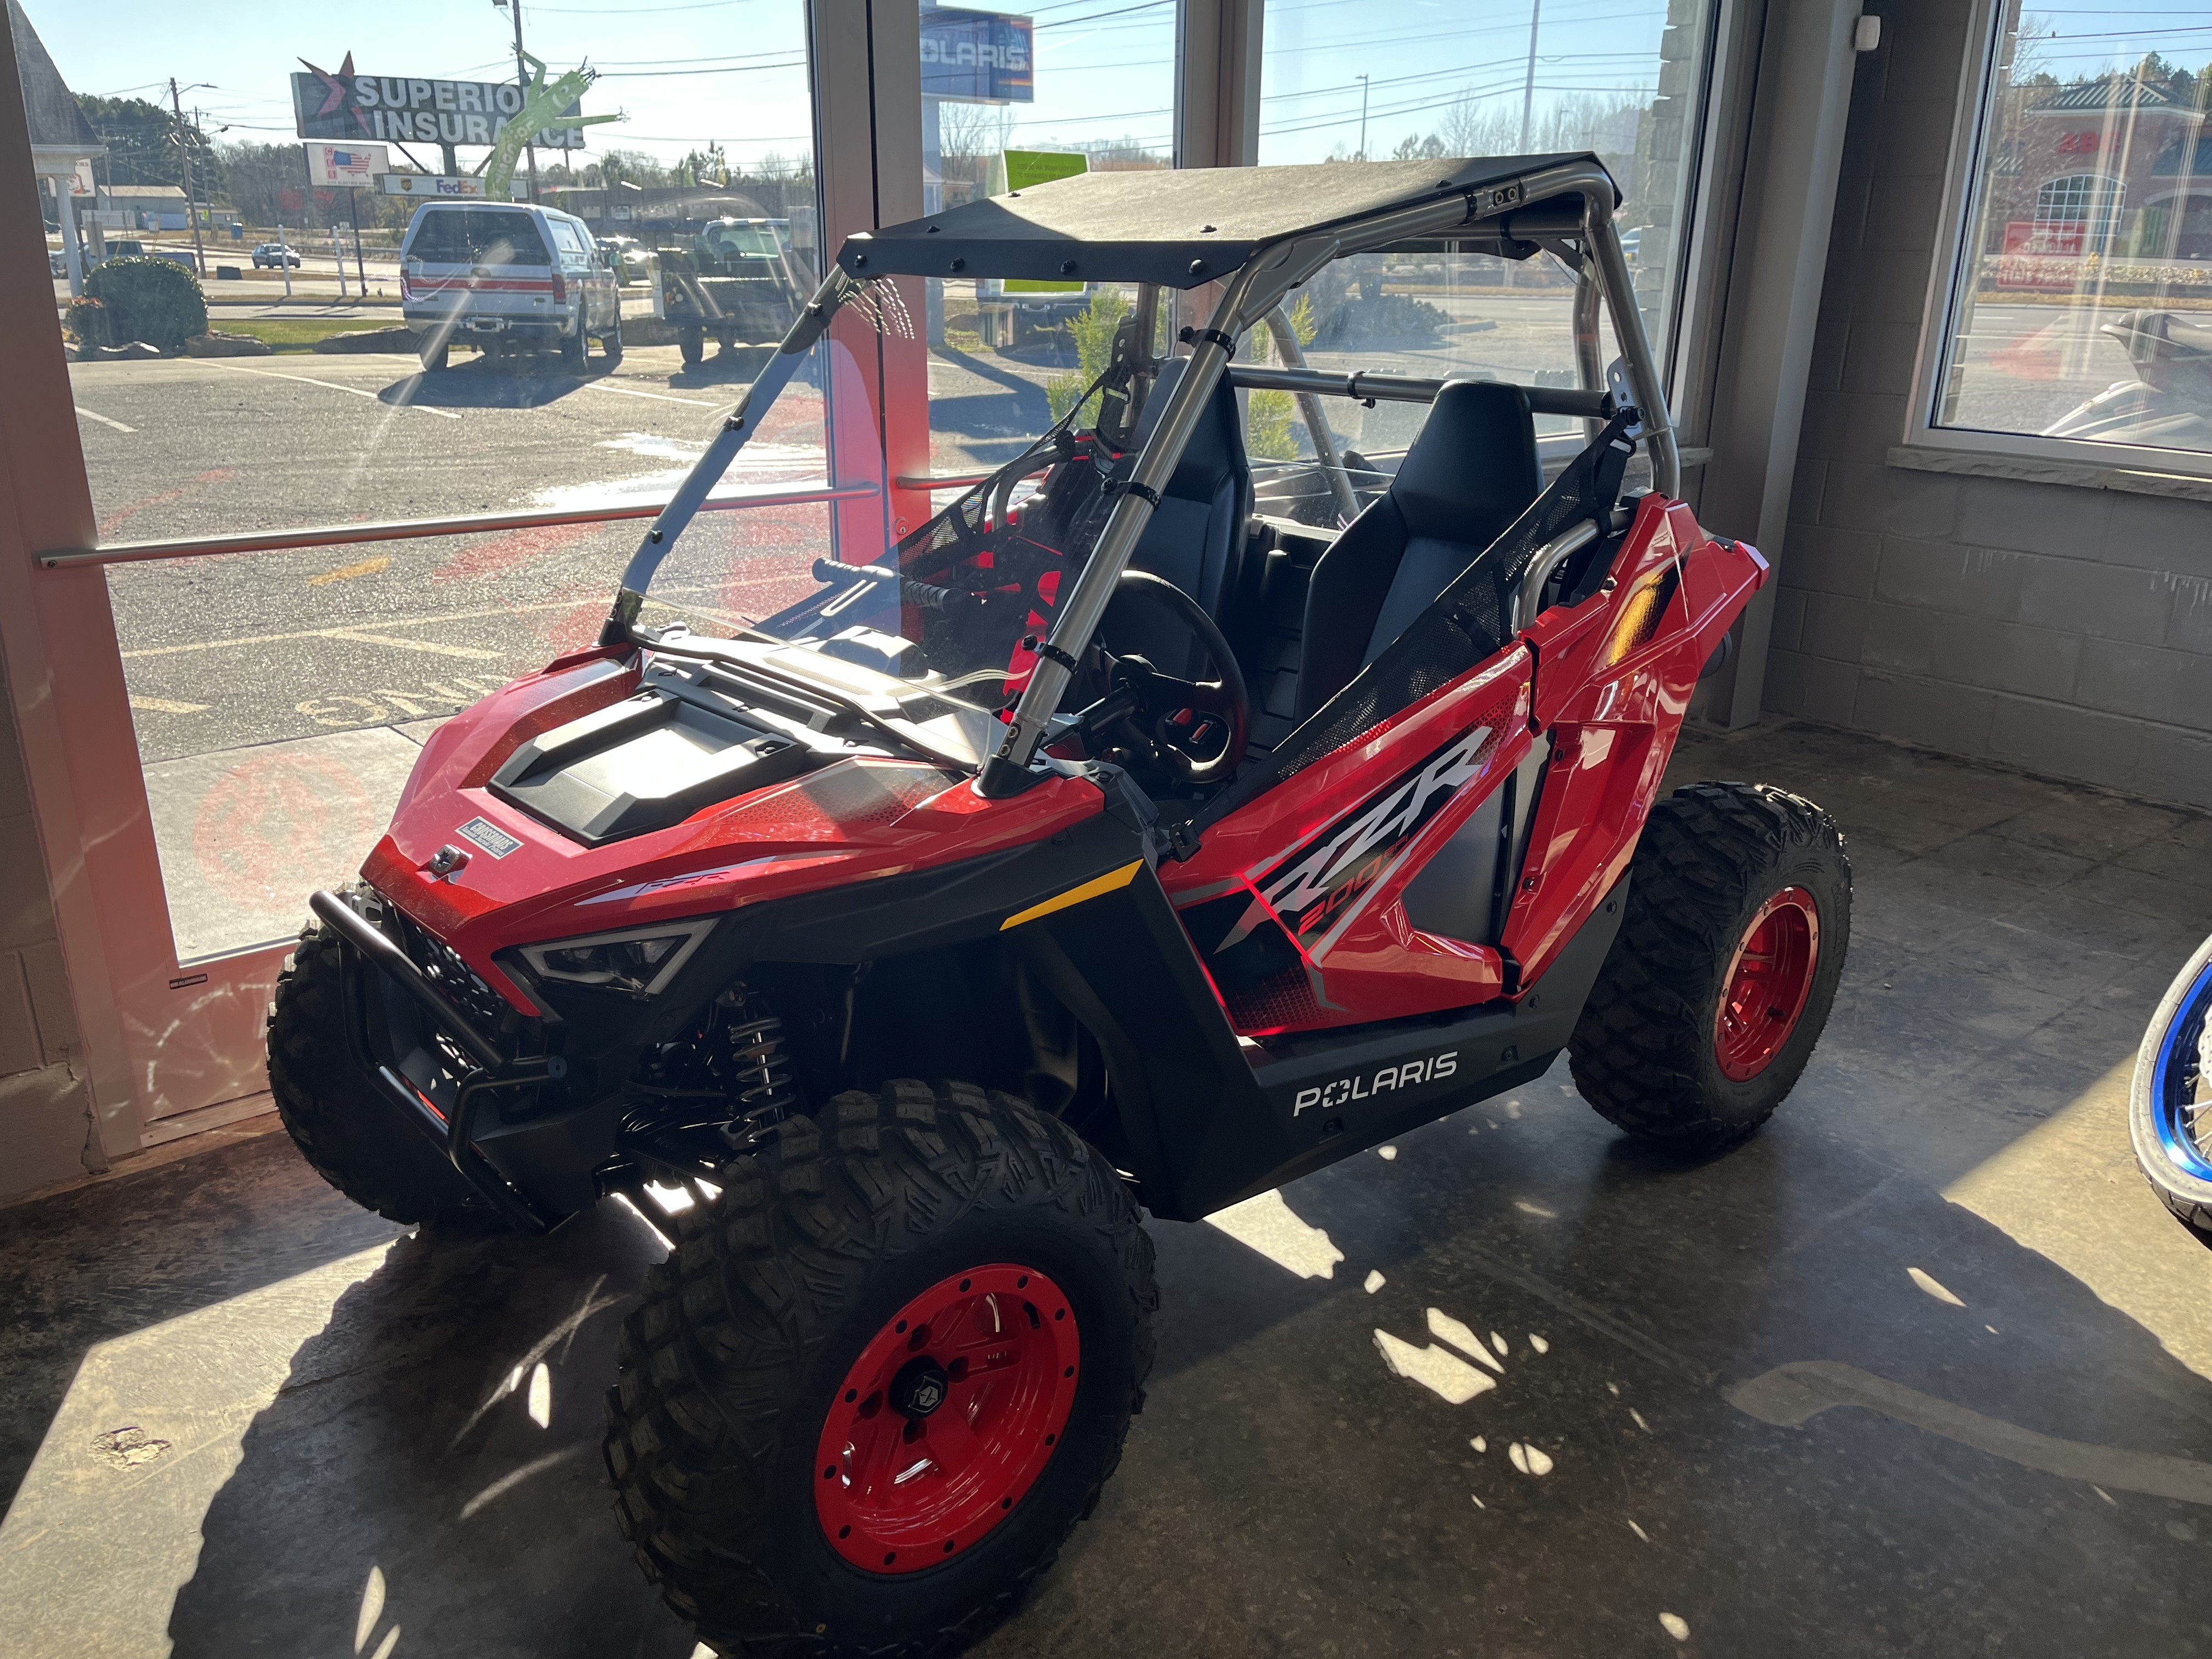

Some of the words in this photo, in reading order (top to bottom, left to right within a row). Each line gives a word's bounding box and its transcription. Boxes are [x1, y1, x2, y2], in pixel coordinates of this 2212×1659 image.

[436, 179, 479, 195] FedEx
[470, 822, 514, 850] CROSSROADS
[1213, 726, 1493, 955] RZR
[1297, 854, 1383, 936] 200
[1293, 1051, 1458, 1117] POLARIS
